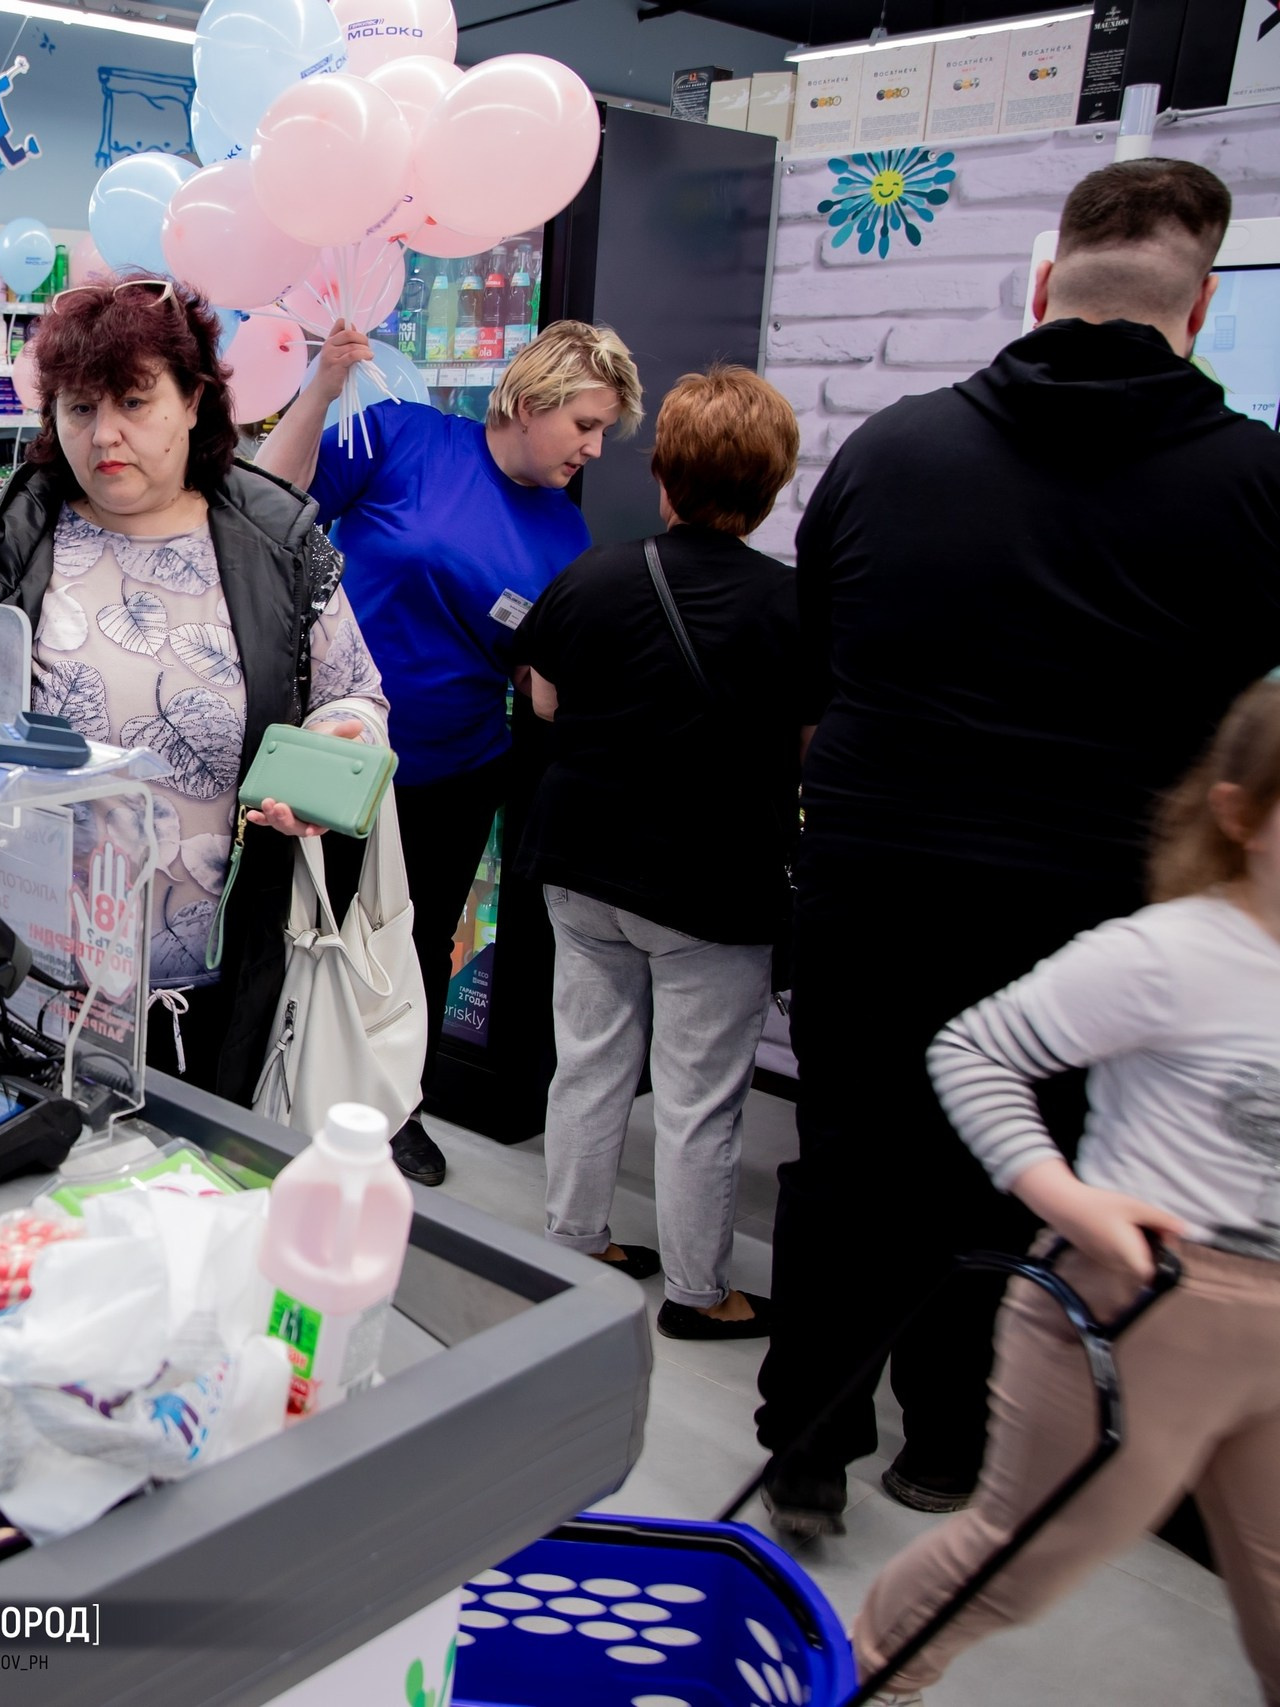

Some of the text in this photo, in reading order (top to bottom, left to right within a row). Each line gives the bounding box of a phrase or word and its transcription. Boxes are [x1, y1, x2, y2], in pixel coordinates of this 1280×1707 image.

[1094, 19, 1129, 30] MAUXION
[347, 26, 423, 41] MOLOKO
[480, 346, 492, 357] ola
[458, 992, 464, 1000] 2
[459, 986, 488, 1000] ГАРАНТИЯ
